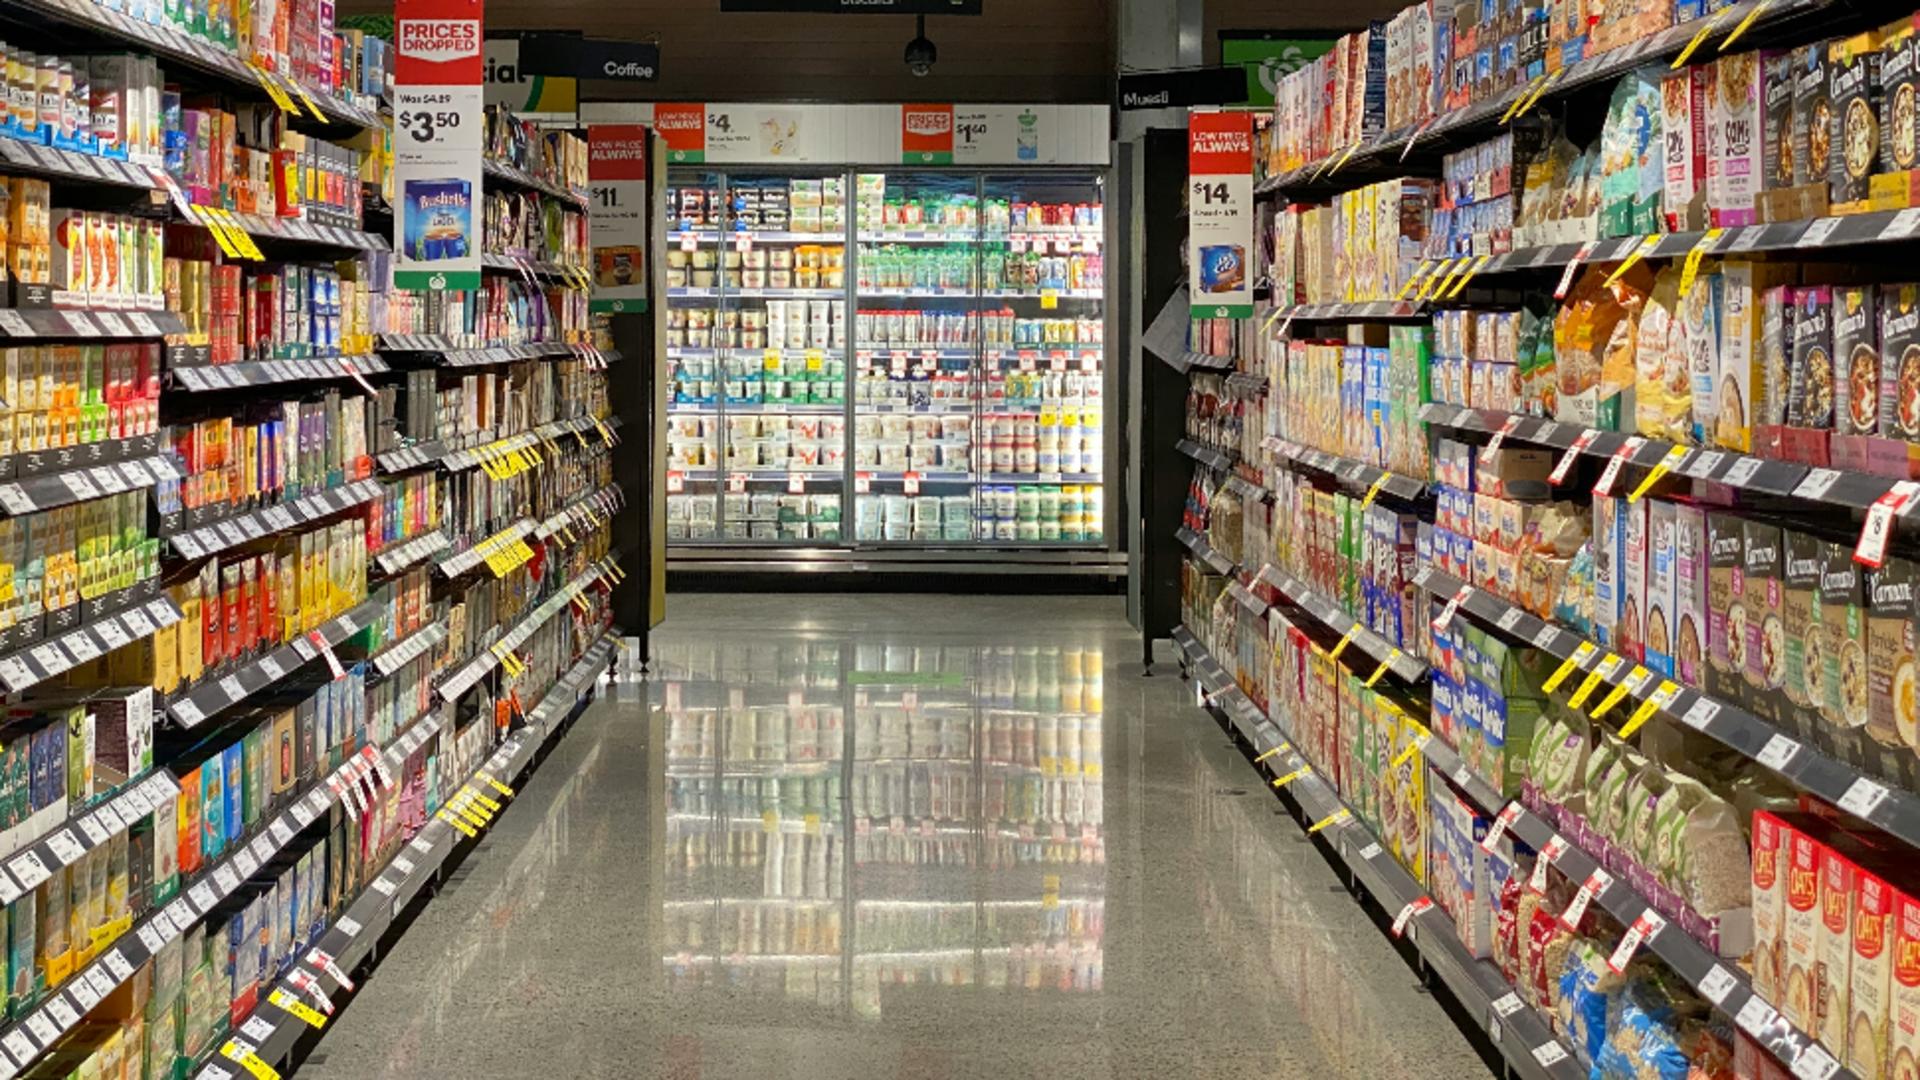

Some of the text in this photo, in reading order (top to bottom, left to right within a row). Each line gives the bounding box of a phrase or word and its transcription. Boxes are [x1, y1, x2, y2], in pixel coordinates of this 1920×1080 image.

[403, 23, 475, 39] PRICES
[403, 39, 475, 51] DROPPED
[603, 60, 654, 78] Coffee
[1123, 91, 1169, 106] Muesli
[657, 120, 702, 130] ALWAYS
[1192, 132, 1216, 141] LOW
[591, 149, 642, 160] ALWAYS
[1192, 141, 1250, 153] ALWAYS
[592, 187, 616, 207] $11
[1193, 182, 1230, 205] $14
[1790, 866, 1816, 904] OATS
[1856, 909, 1882, 944] OATS
